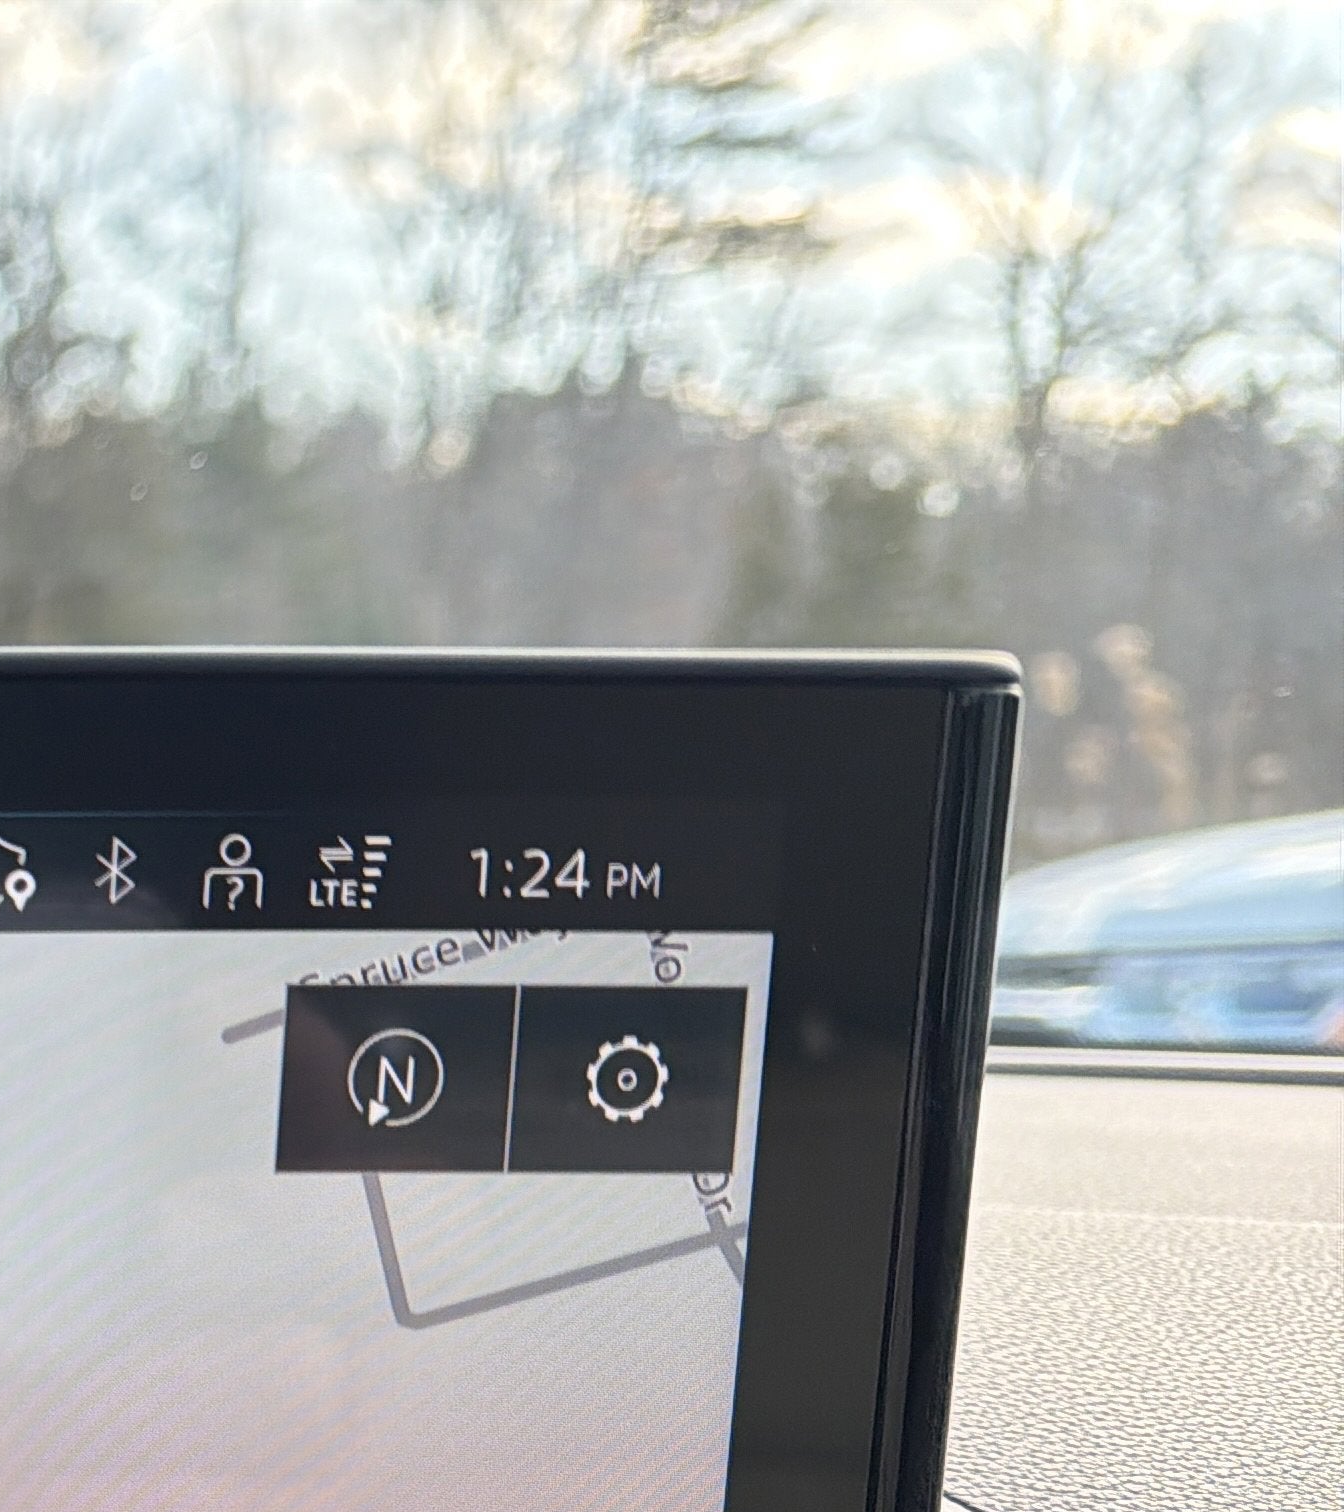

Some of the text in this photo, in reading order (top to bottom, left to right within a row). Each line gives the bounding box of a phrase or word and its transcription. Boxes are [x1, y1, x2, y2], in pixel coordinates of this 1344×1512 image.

[309, 878, 359, 907] LTE
[469, 847, 661, 899] 1:24 PM
